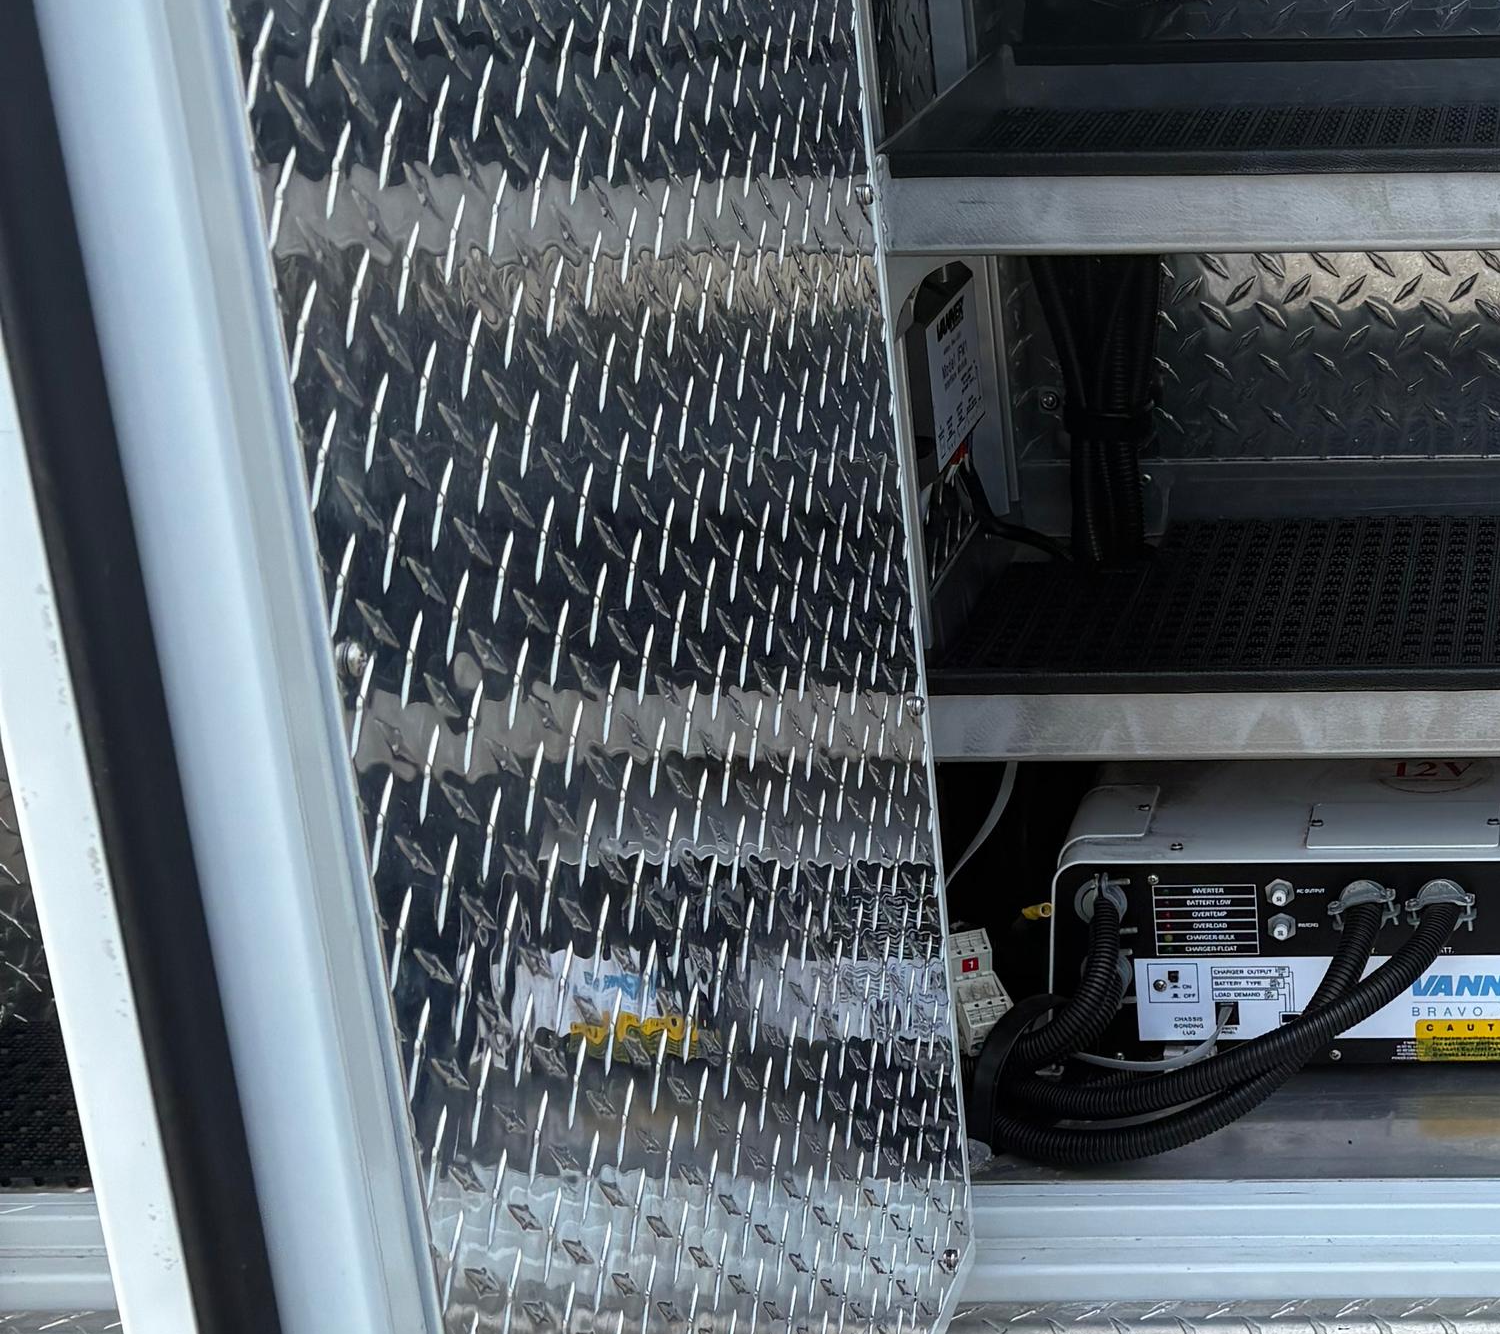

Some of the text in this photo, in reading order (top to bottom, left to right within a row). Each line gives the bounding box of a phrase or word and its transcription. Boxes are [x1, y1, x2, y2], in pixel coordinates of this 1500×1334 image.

[1392, 761, 1474, 778] 12V
[968, 960, 975, 969] 1
[1411, 1006, 1483, 1017] BRAVO
